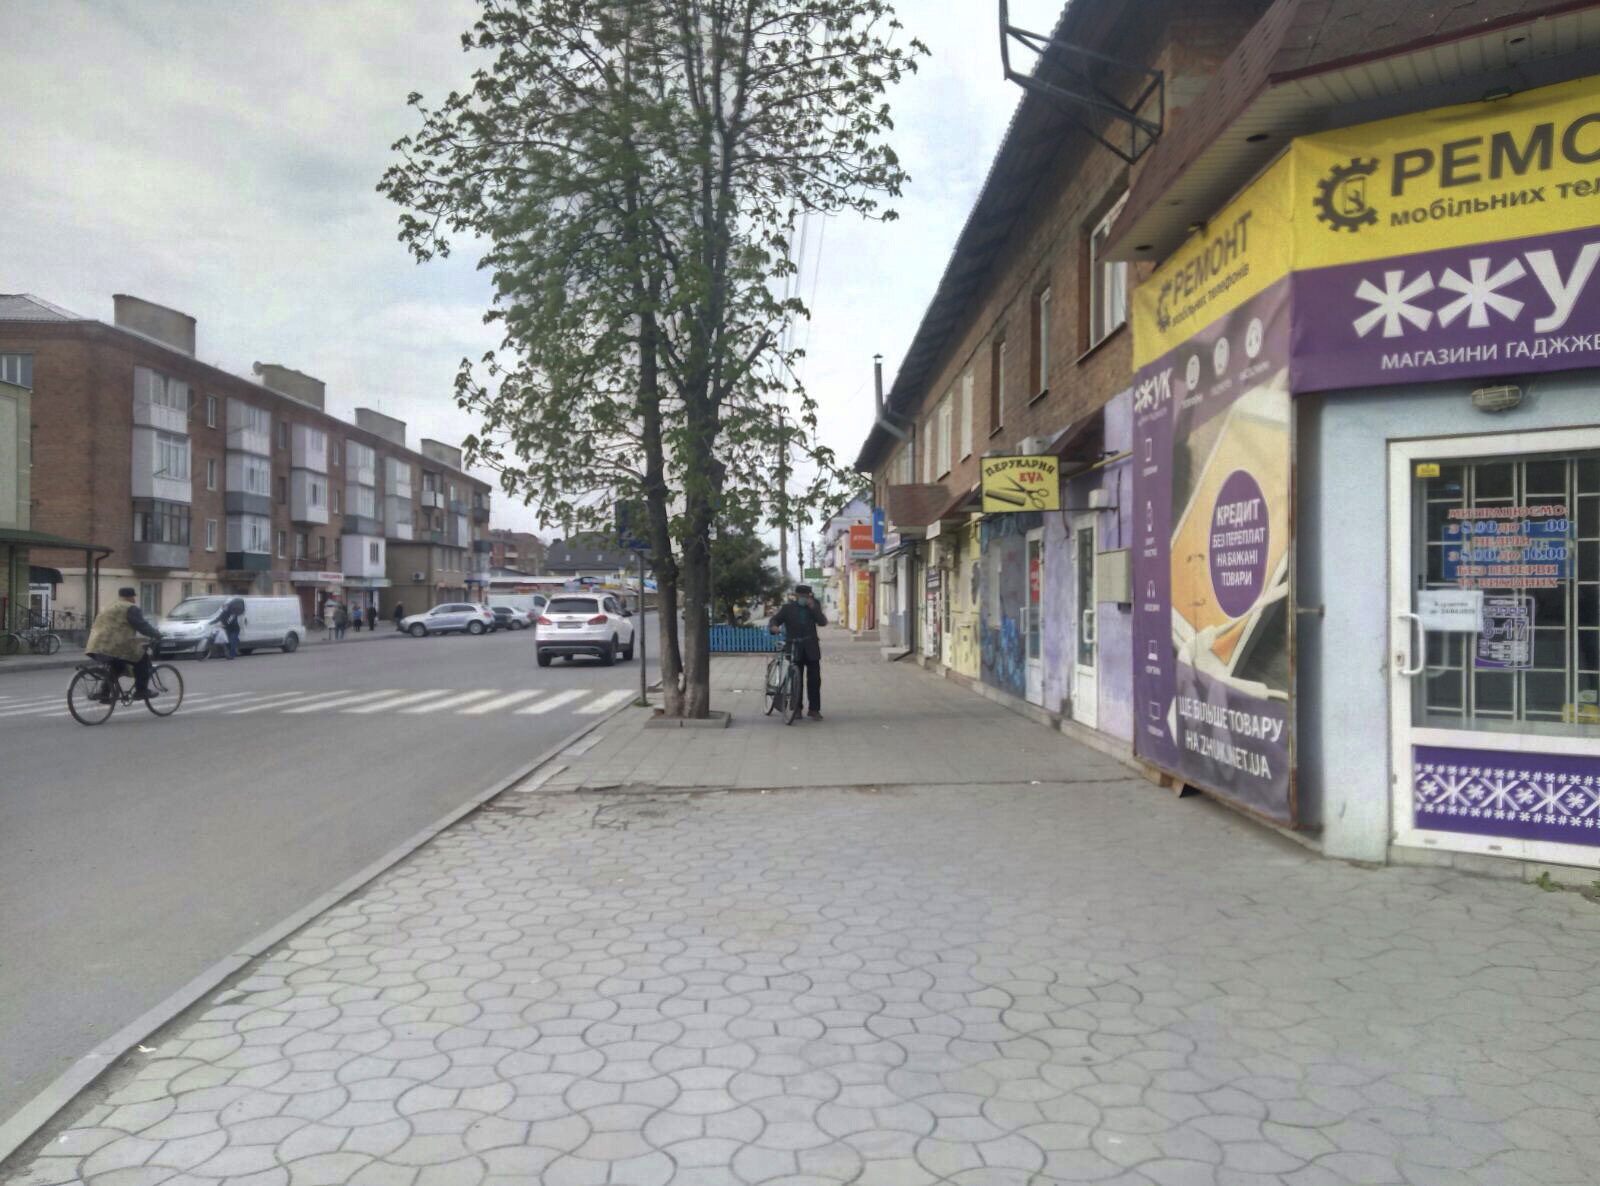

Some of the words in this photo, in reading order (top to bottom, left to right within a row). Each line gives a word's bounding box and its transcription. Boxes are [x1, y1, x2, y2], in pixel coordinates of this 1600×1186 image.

[1390, 184, 1545, 226] мобільних
[1173, 210, 1252, 305] РЕМОНТ
[1381, 345, 1498, 370] МАГАЗИНИ
[985, 459, 1056, 477] ПЕРУКАРНЯ
[1216, 498, 1261, 527] КРЕДИТ
[1212, 533, 1225, 548] БЕЗ
[1225, 527, 1265, 546] ПЕРЕПЛАТ
[1217, 552, 1227, 567] НА
[1227, 549, 1258, 566] БАЖАНІ
[1221, 571, 1253, 586] ТОВАРИ
[1192, 699, 1228, 729] БІЛЬШЕ
[1228, 710, 1284, 743] ТОВАРУ
[1185, 730, 1199, 752] НА
